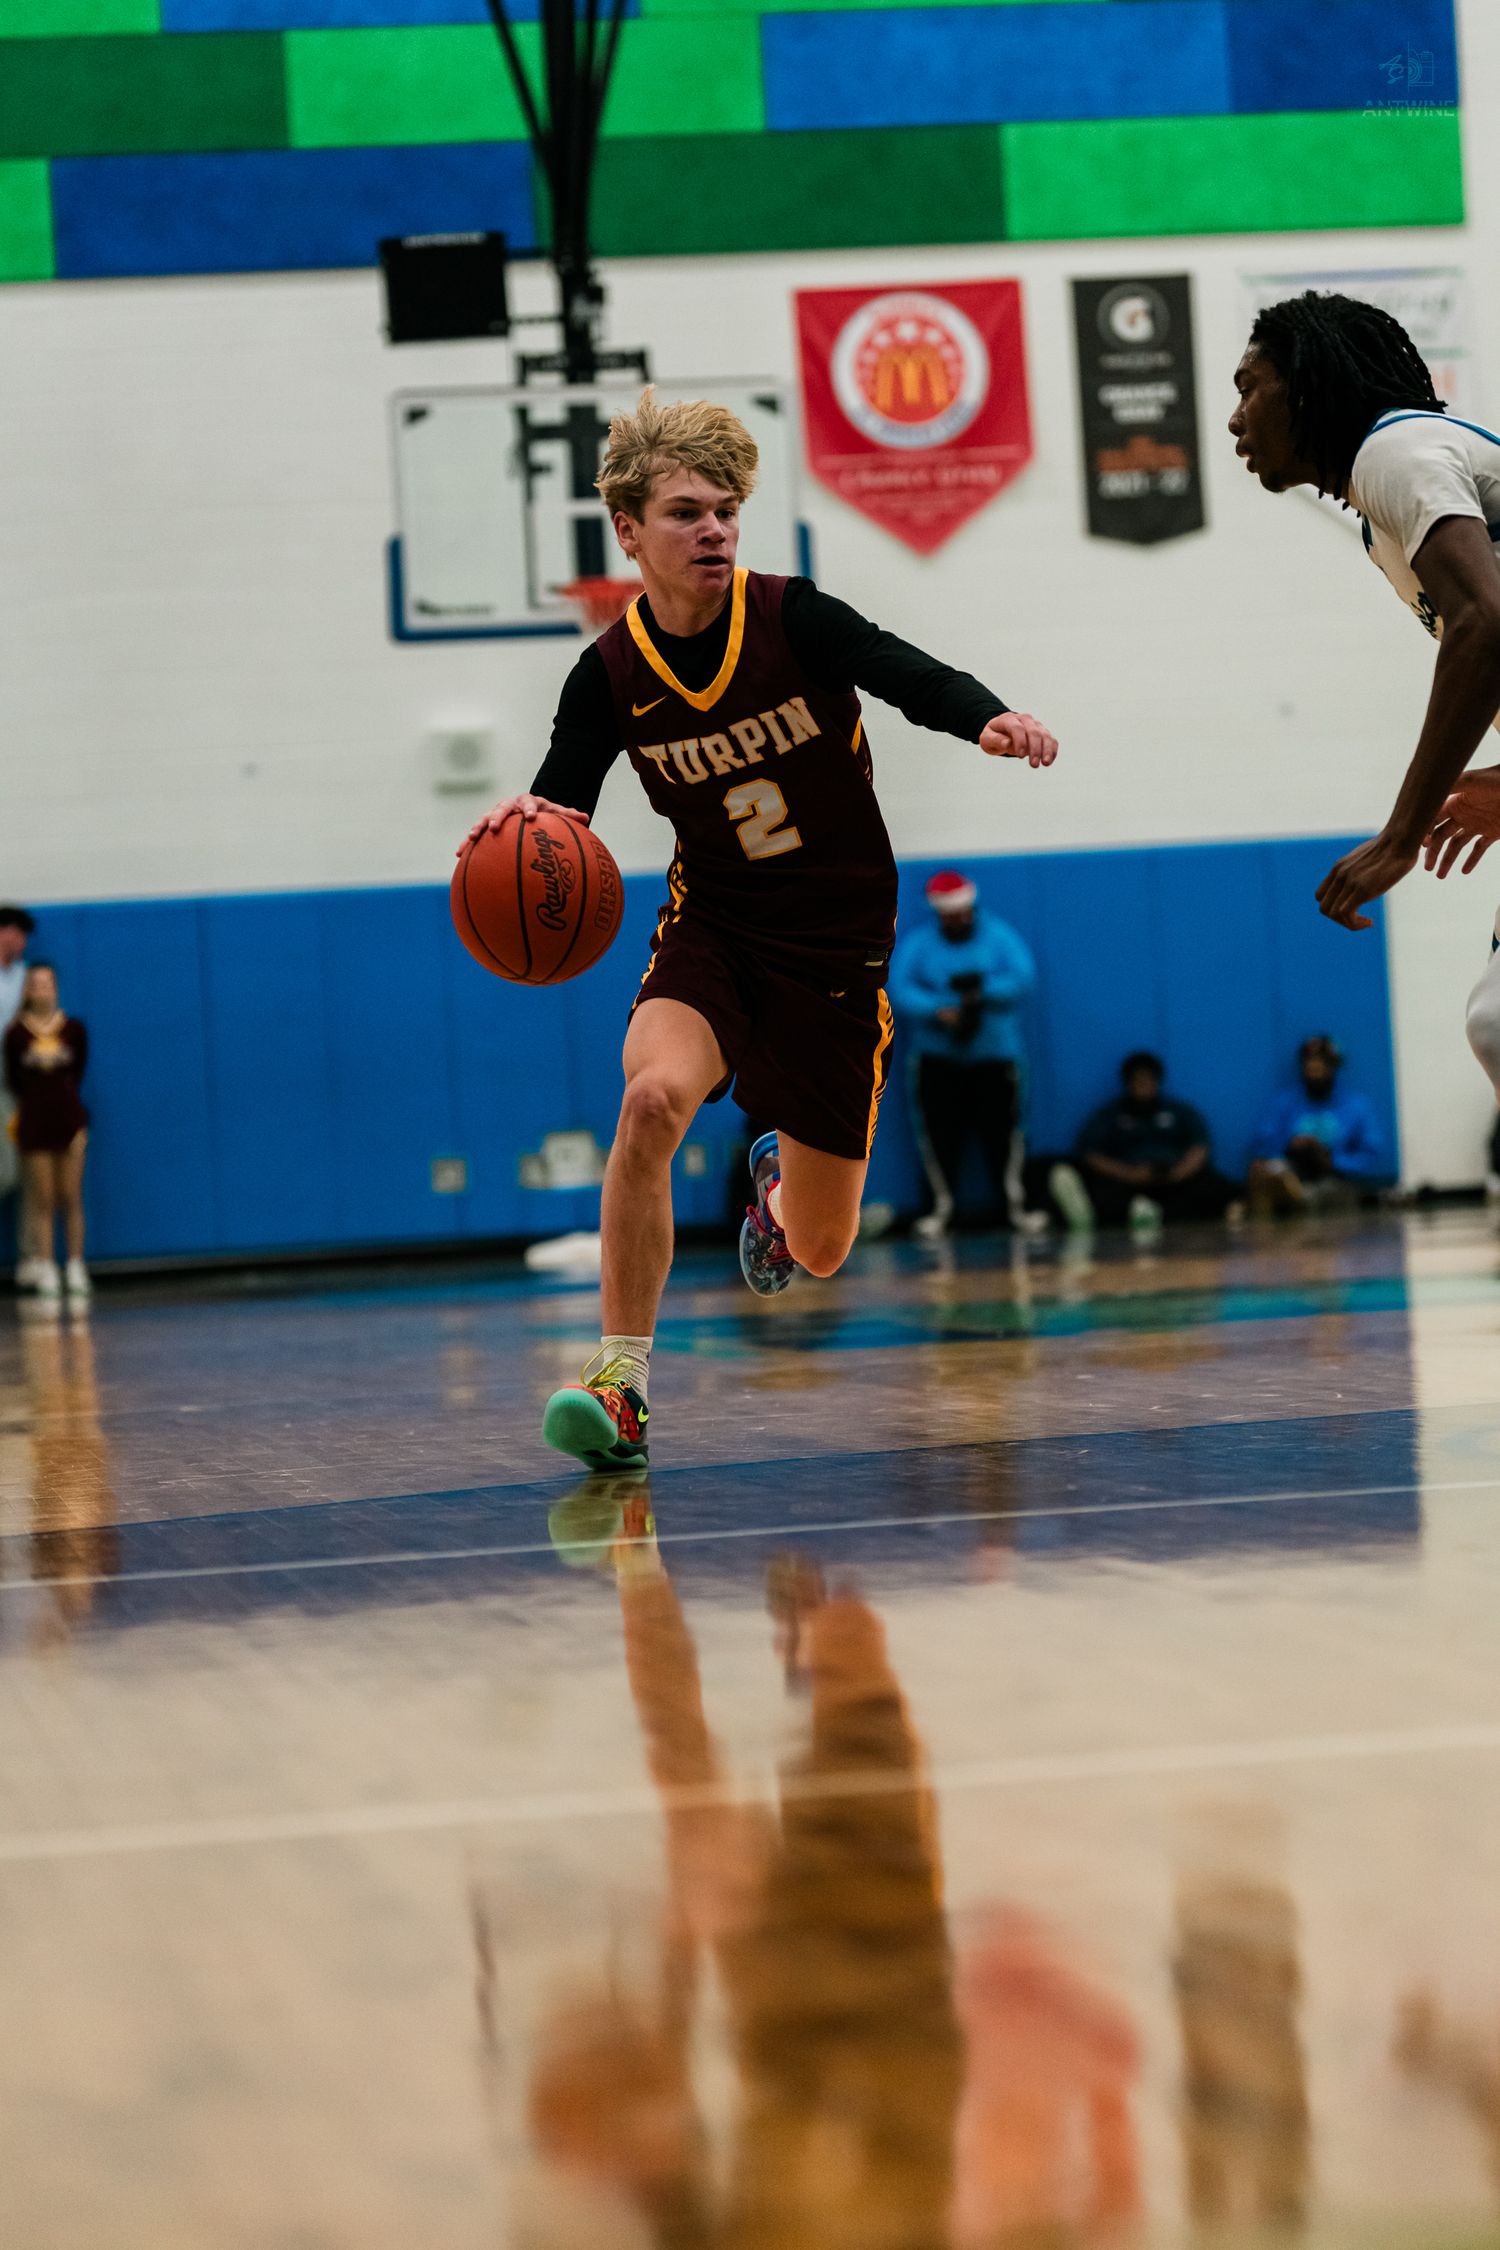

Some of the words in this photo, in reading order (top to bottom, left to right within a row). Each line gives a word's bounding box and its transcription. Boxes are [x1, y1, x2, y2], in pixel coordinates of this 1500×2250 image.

[638, 696, 822, 785] TURPIN
[722, 777, 803, 861] 2
[530, 828, 566, 931] Rawlings
